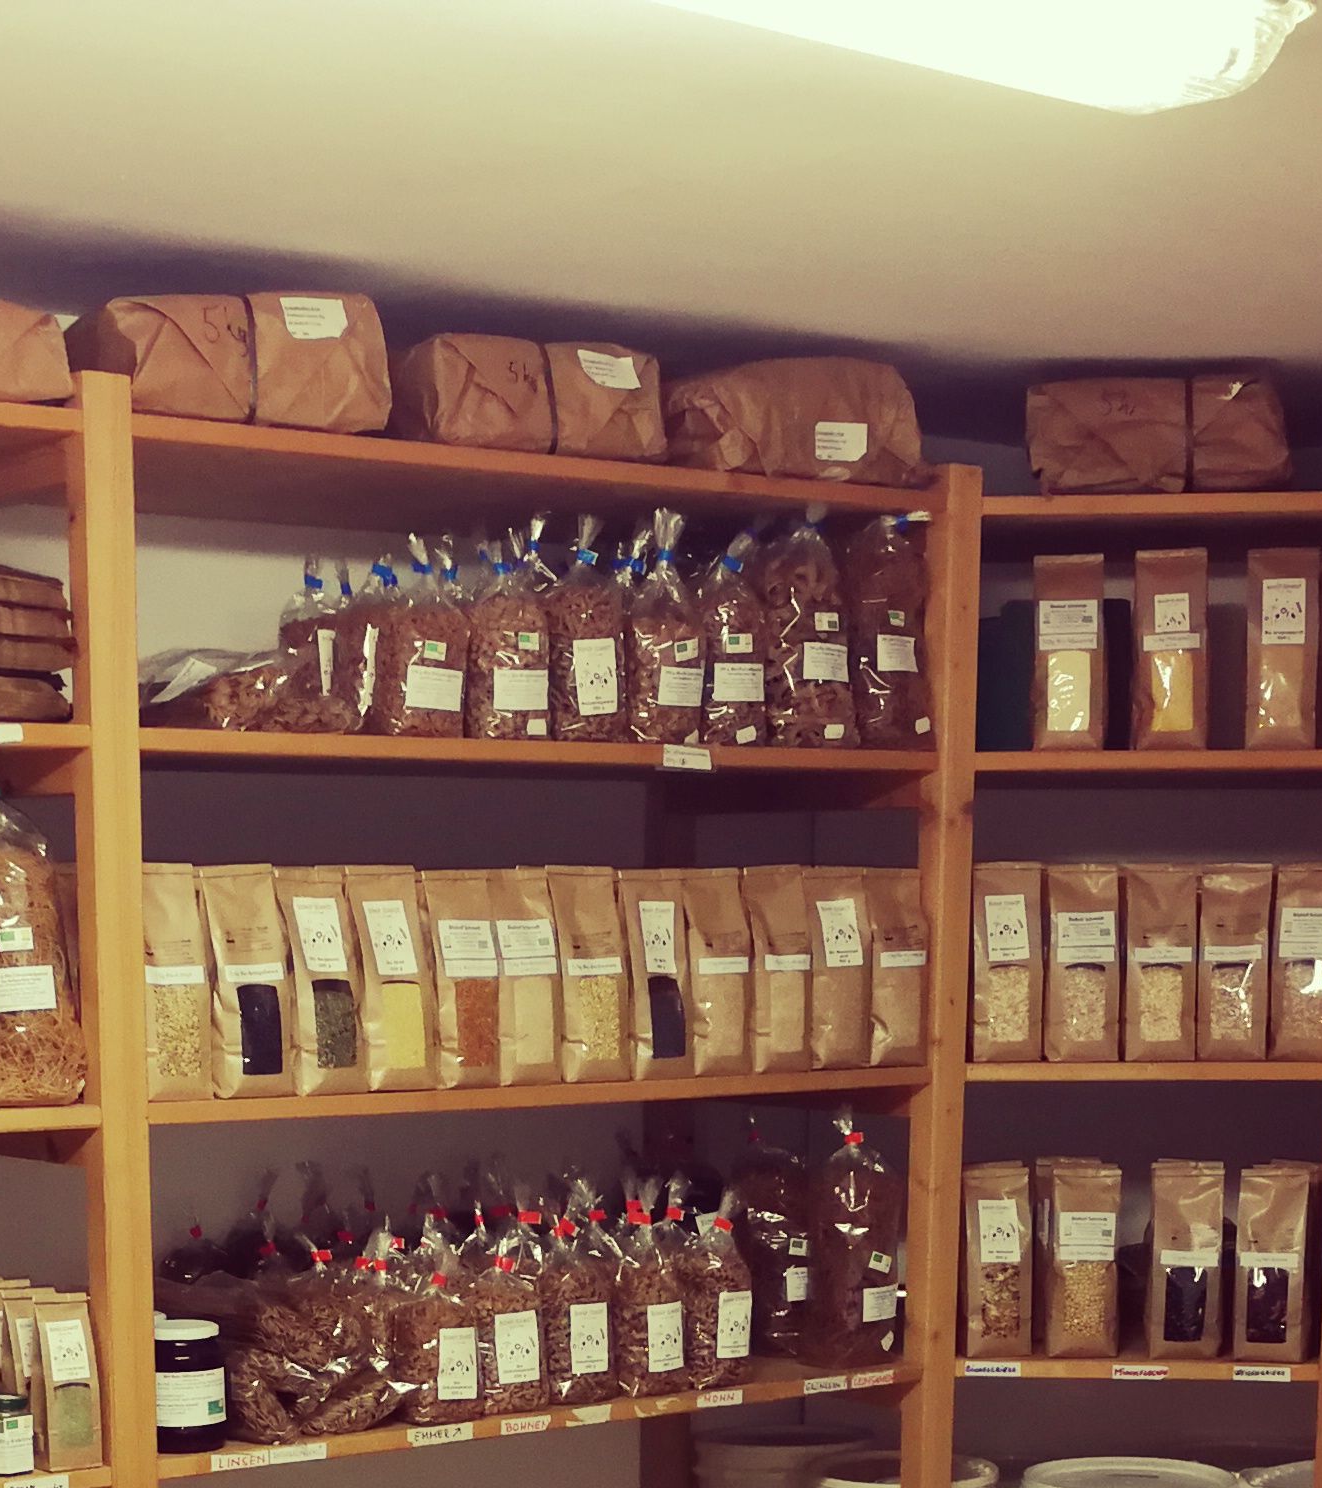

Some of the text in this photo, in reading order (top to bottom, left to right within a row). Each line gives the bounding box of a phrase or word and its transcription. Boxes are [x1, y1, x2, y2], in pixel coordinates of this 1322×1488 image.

[201, 305, 221, 345] 5
[705, 1392, 735, 1403] MOHN
[505, 1421, 547, 1433] BOHNEN
[414, 1430, 449, 1442] EMMER
[218, 1455, 266, 1469] LINSEN
